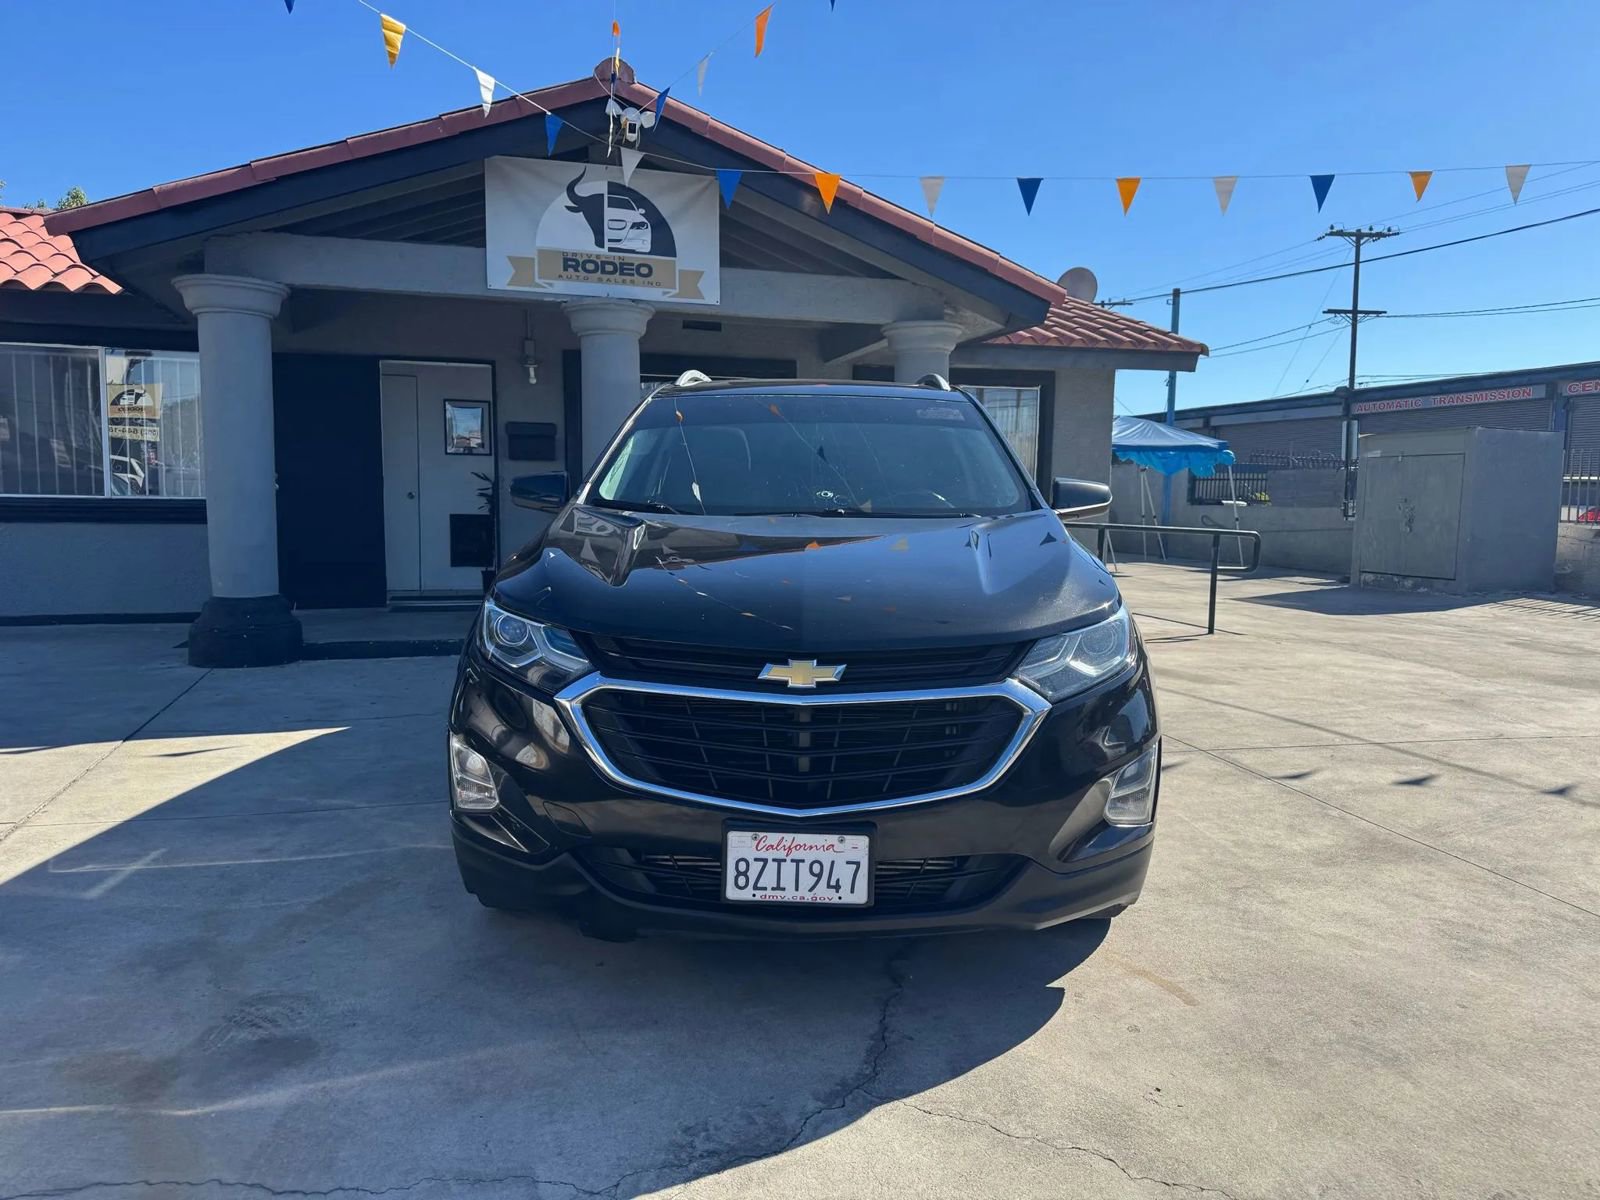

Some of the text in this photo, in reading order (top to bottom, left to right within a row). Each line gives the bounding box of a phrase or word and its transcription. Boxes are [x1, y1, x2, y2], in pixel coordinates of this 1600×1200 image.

[561, 251, 625, 261] DRIVE-IN
[562, 256, 653, 278] RODEO
[558, 273, 589, 281] AUTO
[597, 276, 636, 285] SALES
[1355, 387, 1533, 413] AUTOMATIC TRANSMISSION
[755, 834, 845, 857] California
[733, 857, 861, 894] 8ZIT947
[759, 893, 834, 902] dmv.ca.gov
